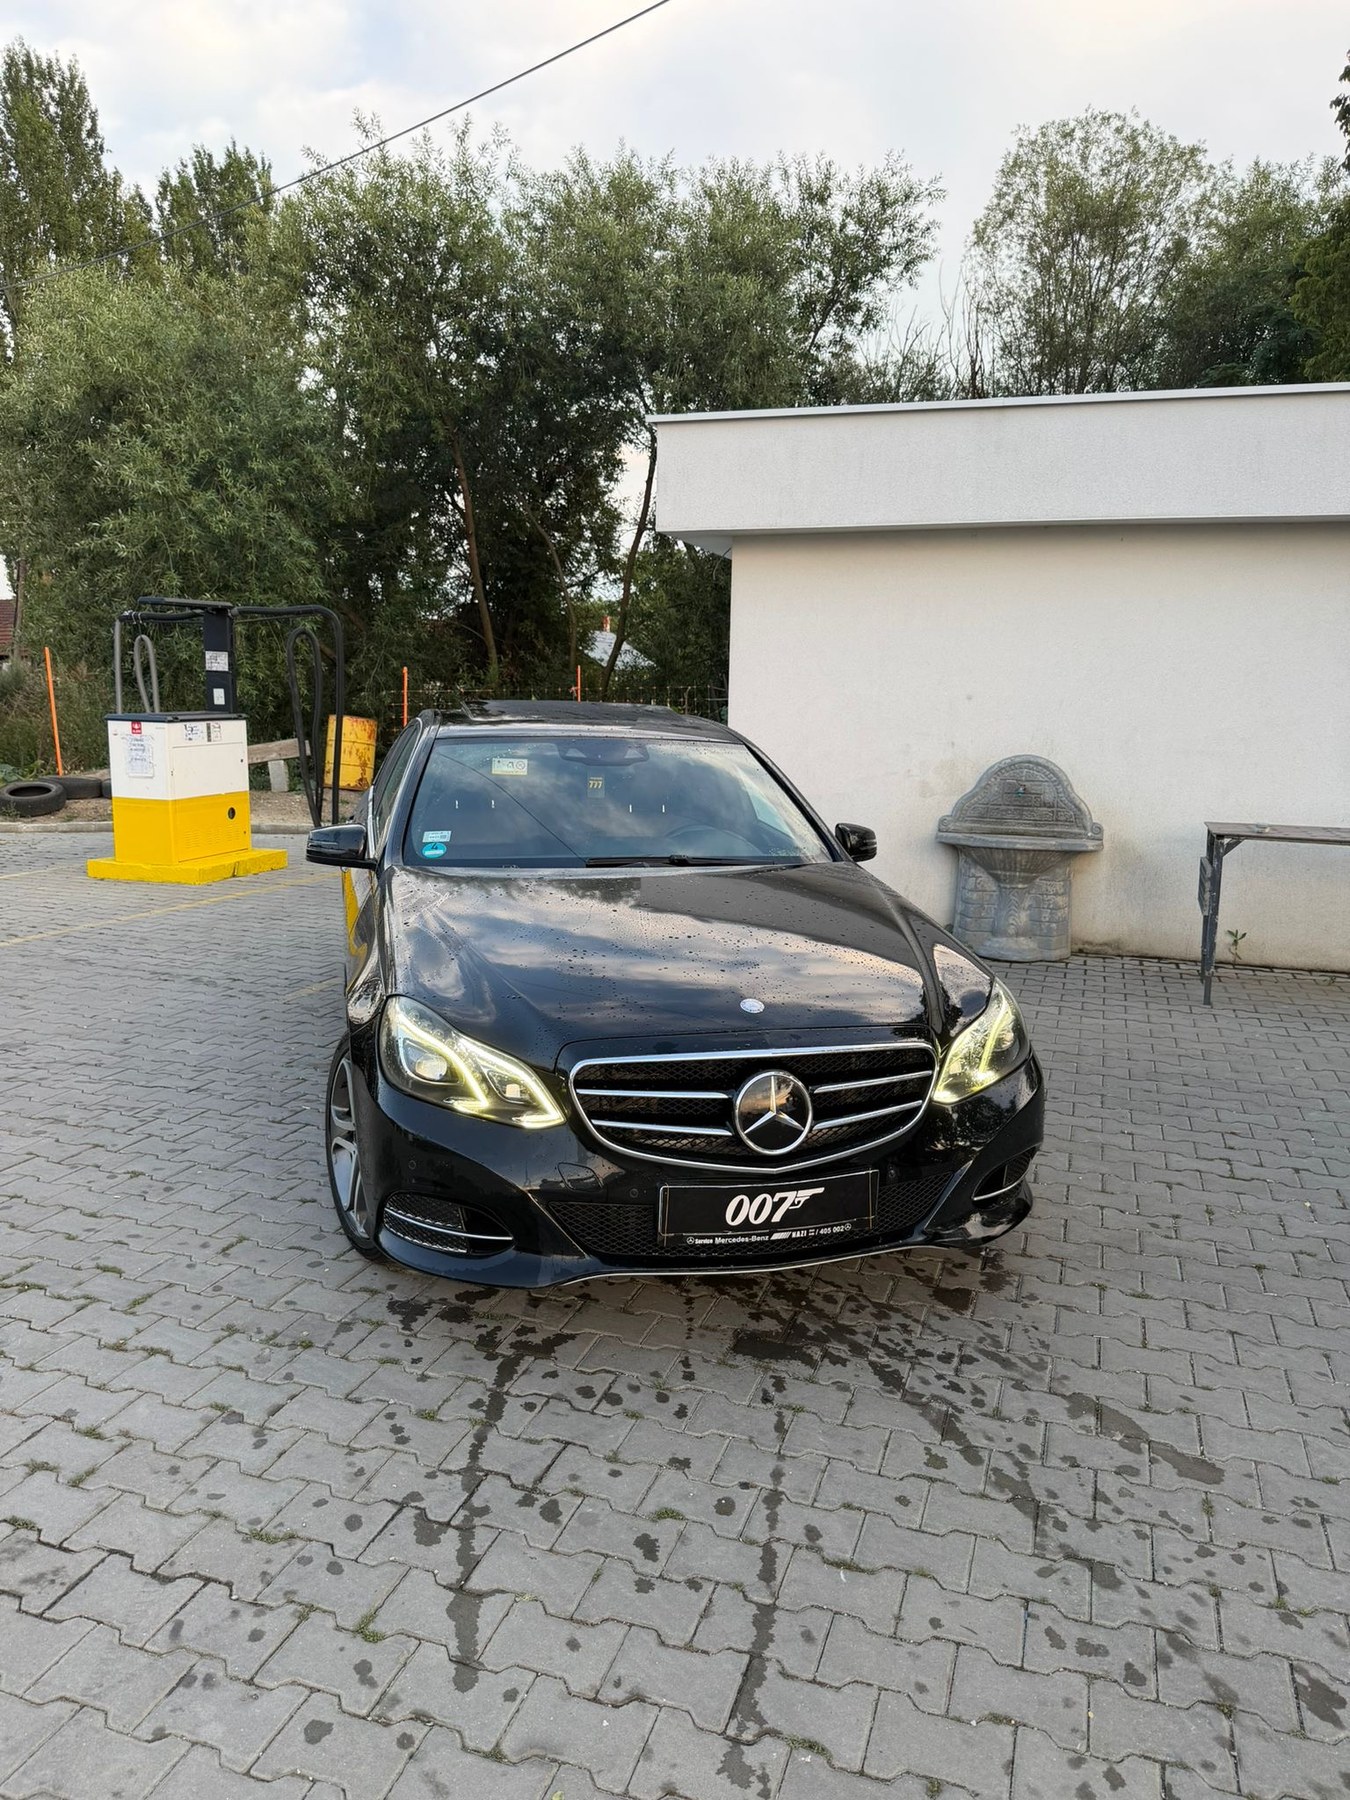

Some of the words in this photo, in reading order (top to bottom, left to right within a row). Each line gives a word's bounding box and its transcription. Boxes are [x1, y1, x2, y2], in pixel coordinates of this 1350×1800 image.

[589, 780, 602, 789] 777
[725, 1190, 797, 1226] 007
[714, 1235, 769, 1244] Mercedes-Benz
[819, 1227, 832, 1235] 405
[832, 1225, 845, 1233] 002
